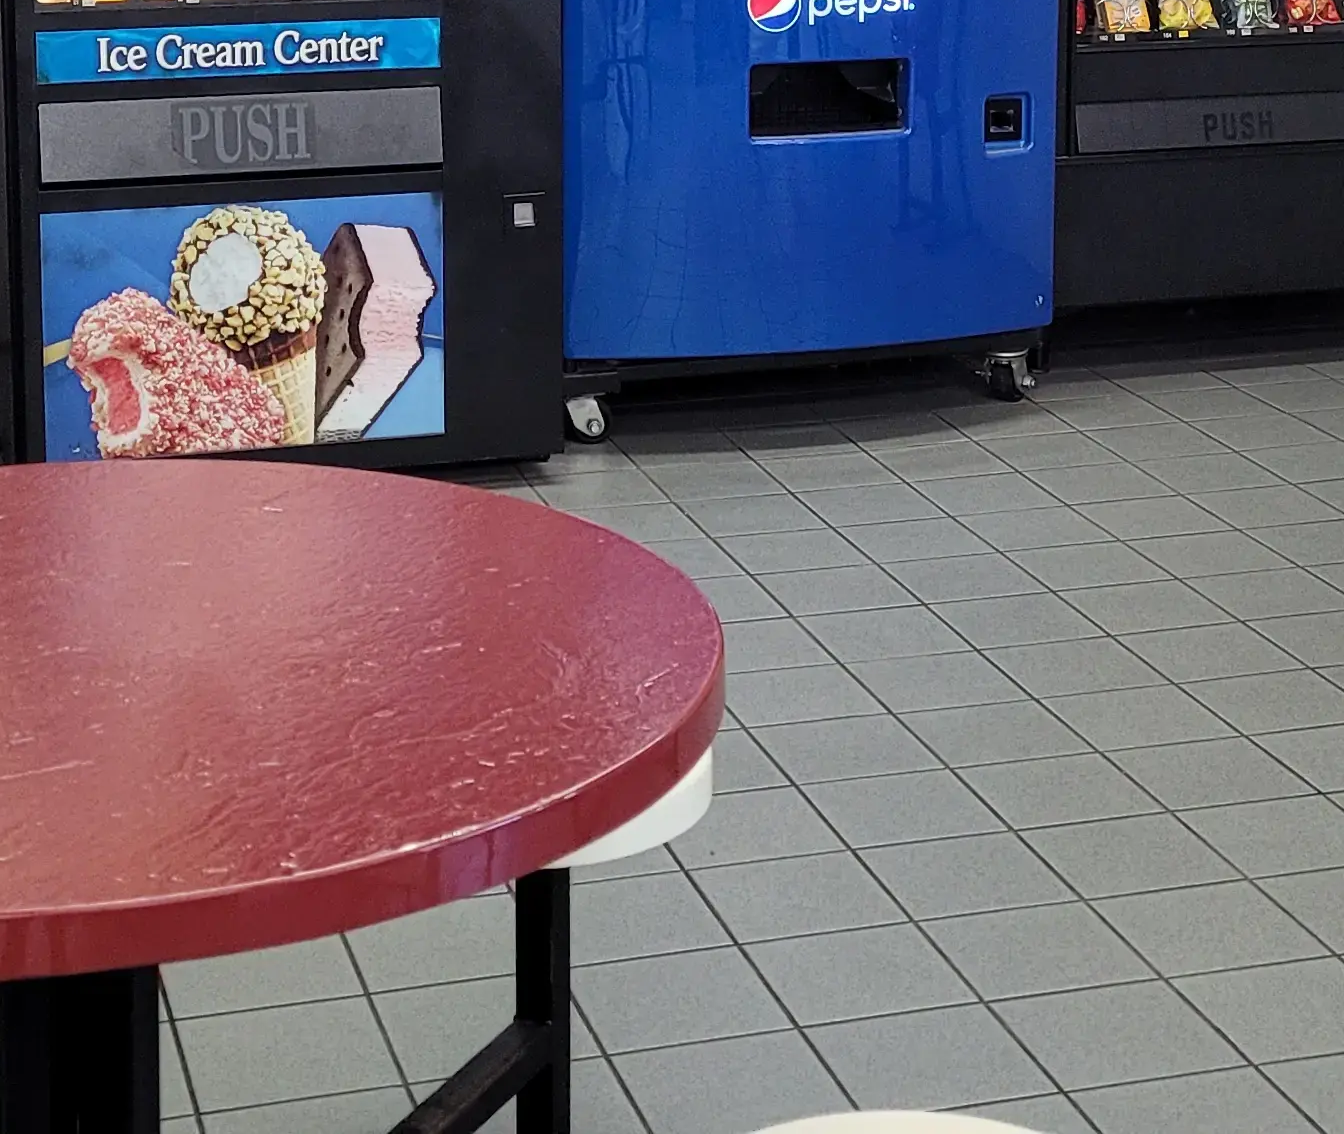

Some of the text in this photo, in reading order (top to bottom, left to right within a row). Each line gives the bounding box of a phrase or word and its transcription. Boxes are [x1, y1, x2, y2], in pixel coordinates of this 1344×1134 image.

[97, 29, 385, 74] Ice Cream Center
[177, 101, 313, 164] PUSH
[1203, 110, 1275, 143] PUSH
